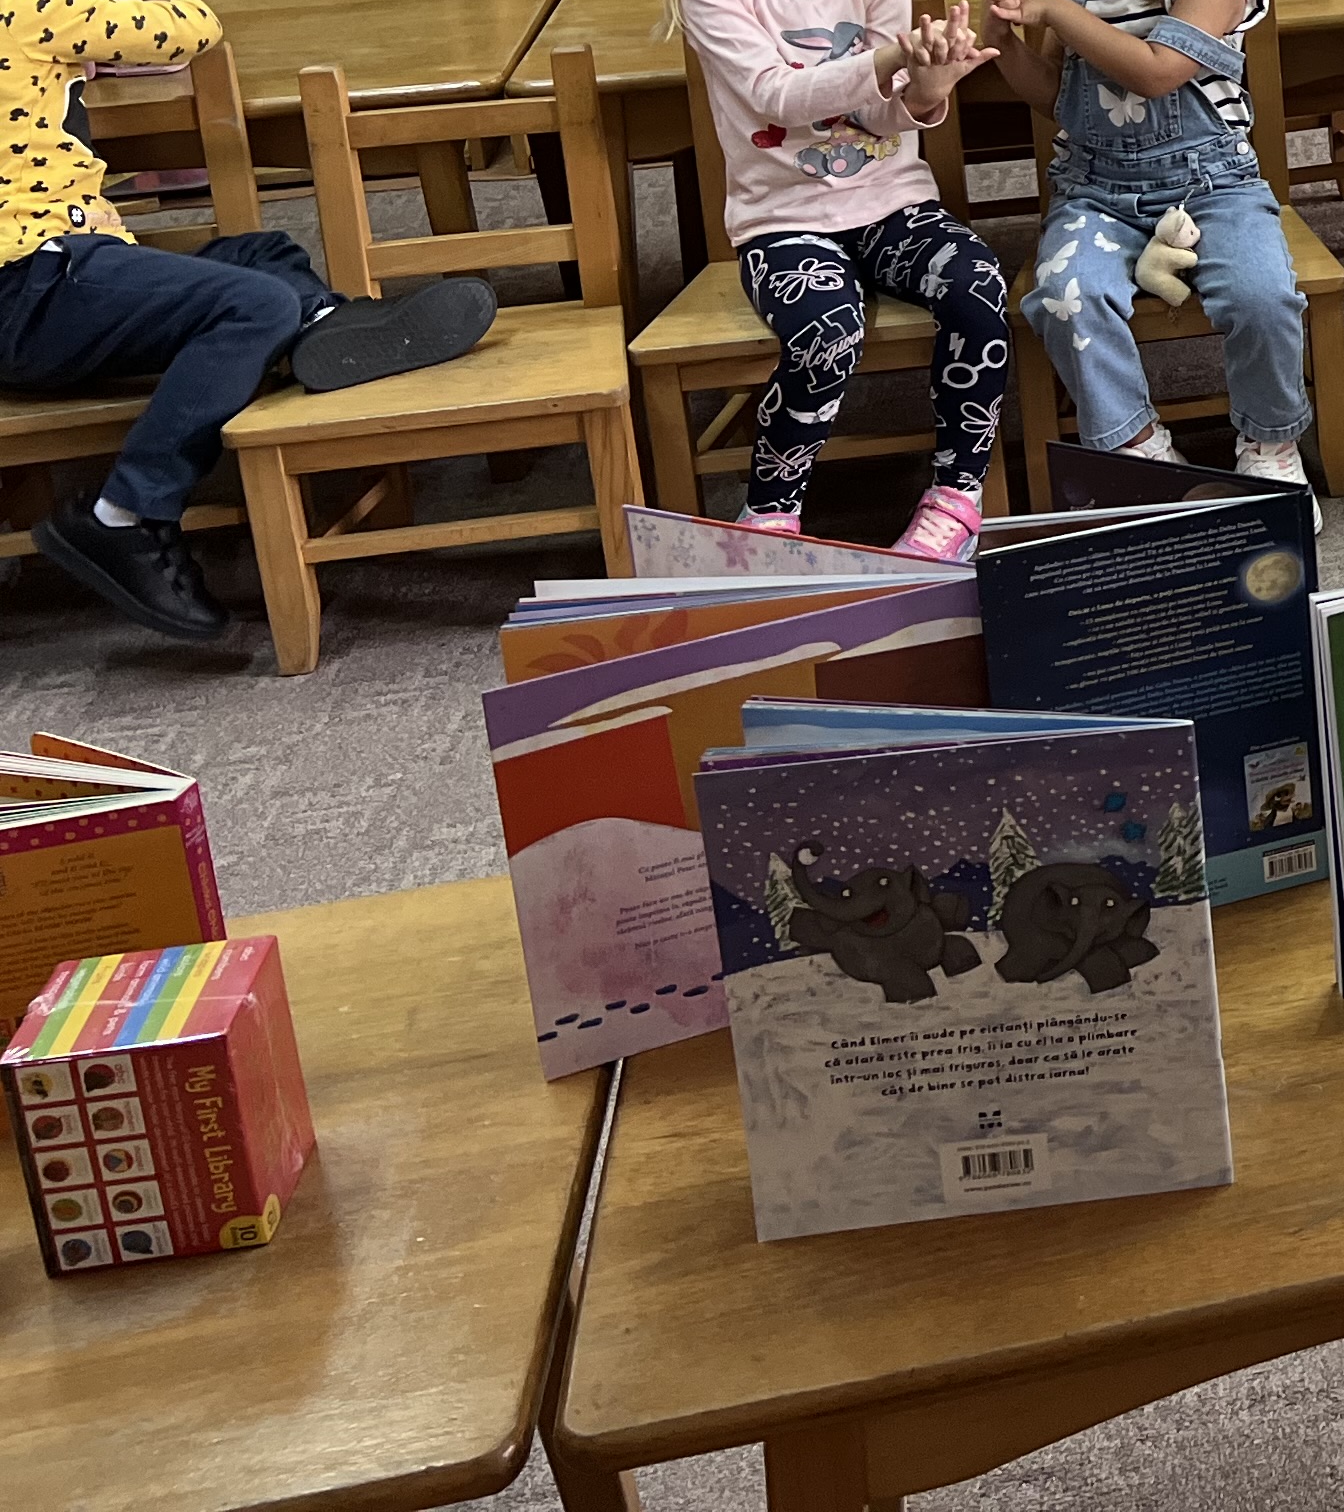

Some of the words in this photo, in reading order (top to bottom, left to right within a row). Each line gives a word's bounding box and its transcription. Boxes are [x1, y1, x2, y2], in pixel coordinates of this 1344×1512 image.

[831, 1036, 866, 1050] Când
[869, 1034, 906, 1047] Elmer
[922, 1029, 955, 1041] aude
[959, 1028, 976, 1041] pe
[185, 1066, 217, 1094] My
[194, 1097, 224, 1140] First
[203, 1144, 238, 1215] Library
[238, 1225, 257, 1241] 10
